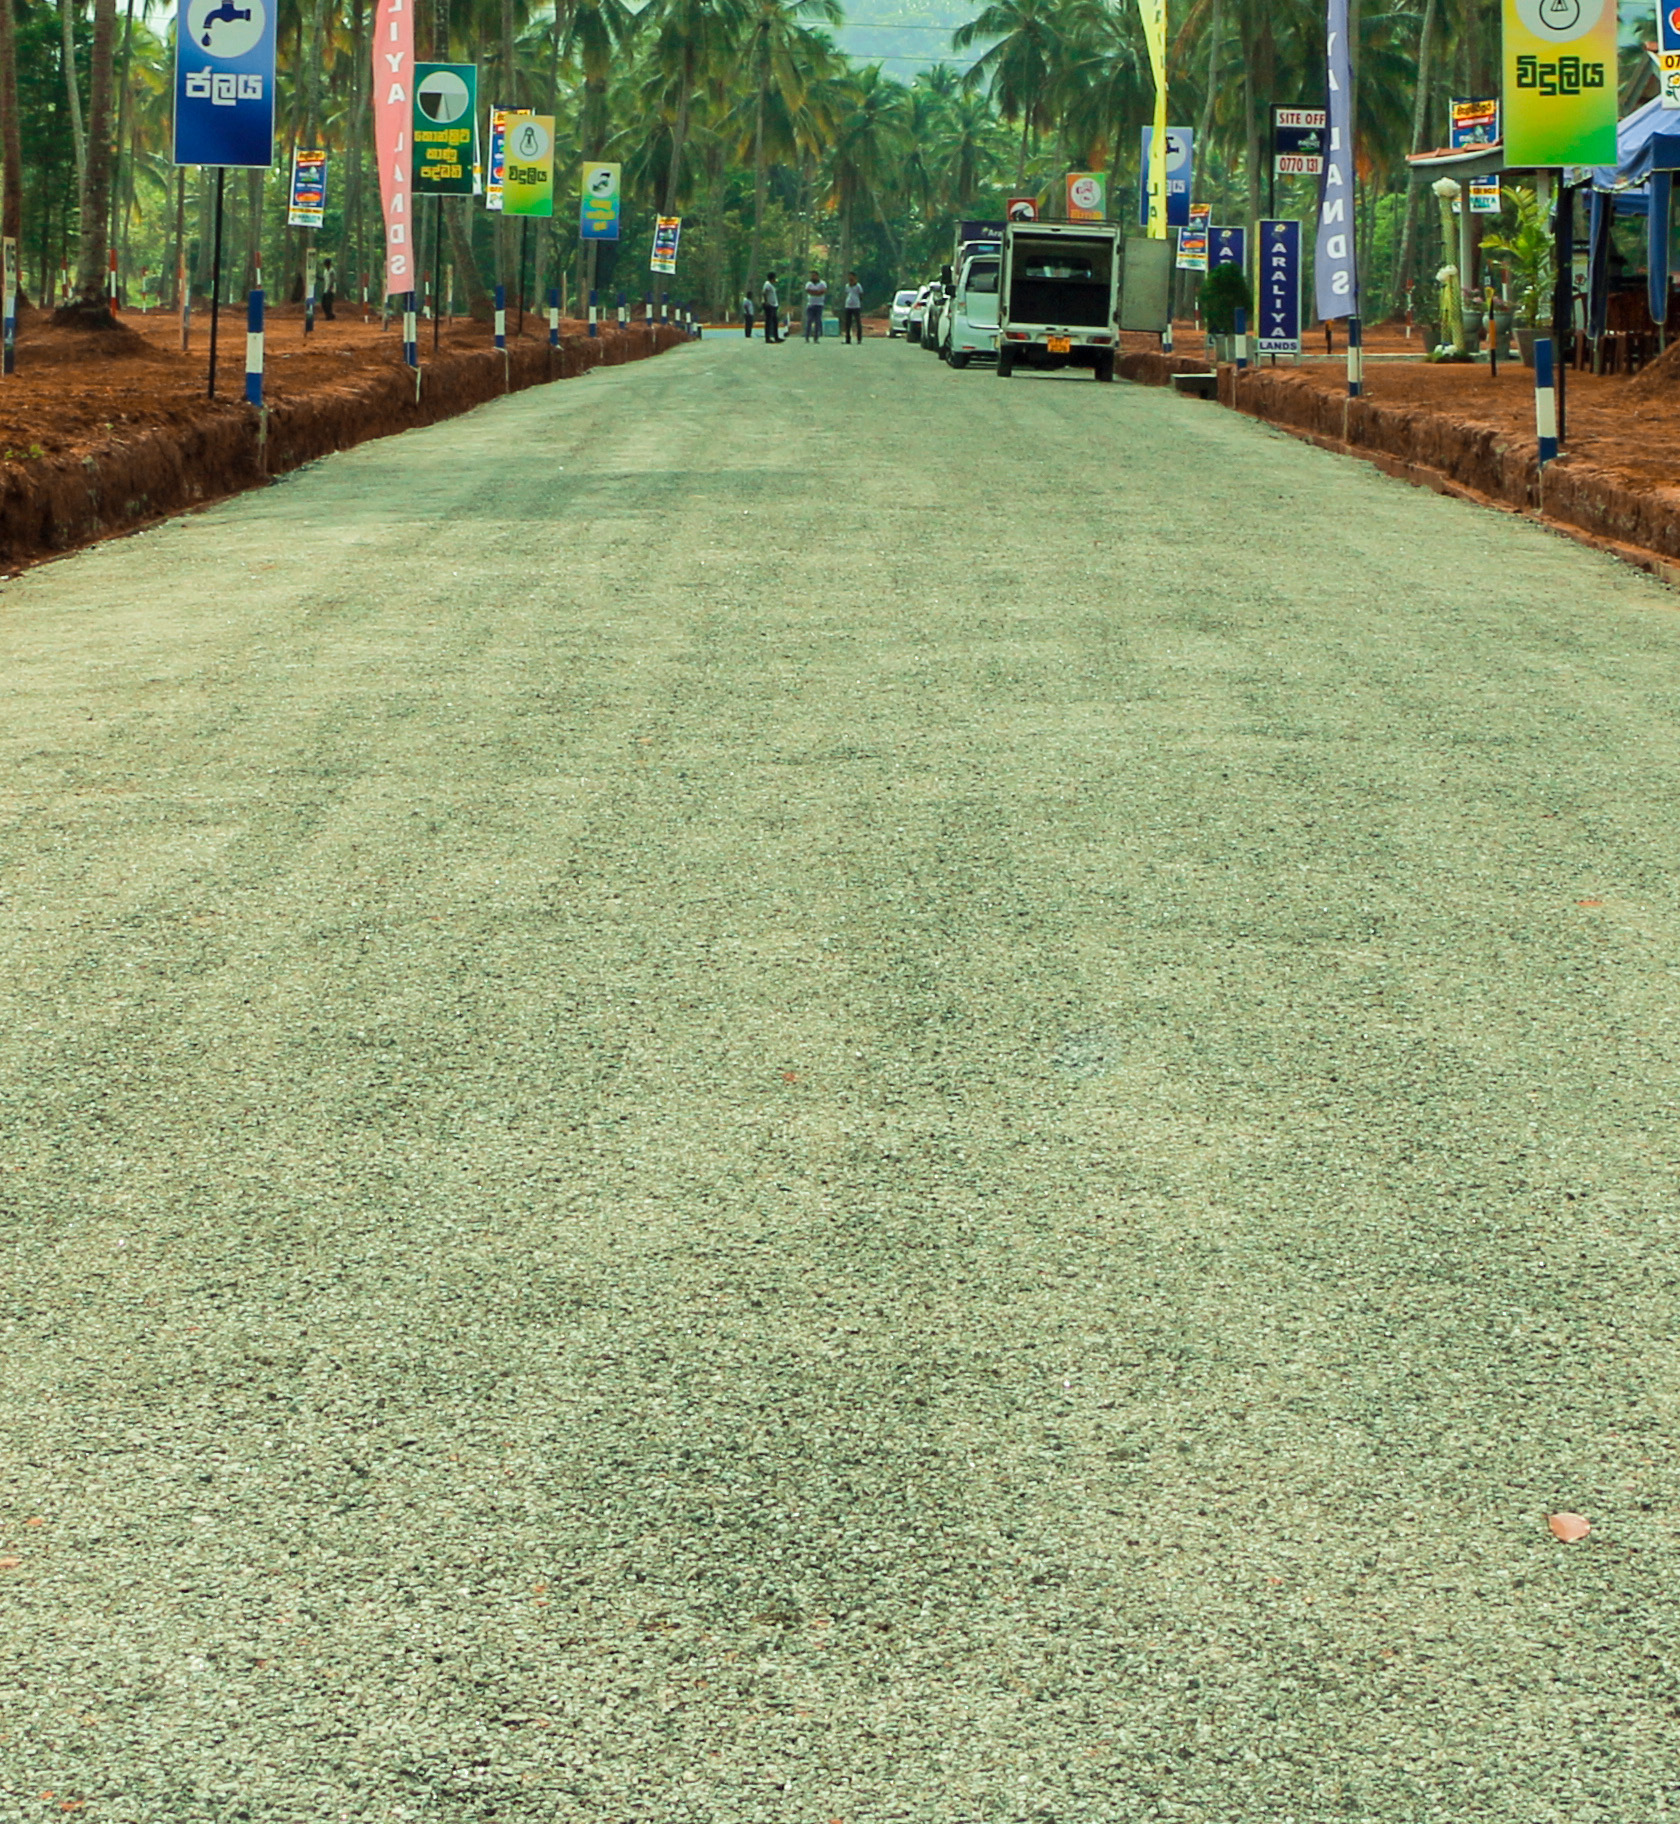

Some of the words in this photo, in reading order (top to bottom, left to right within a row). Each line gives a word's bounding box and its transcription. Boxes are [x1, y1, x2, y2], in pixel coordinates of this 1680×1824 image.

[185, 66, 263, 107] ජලය
[1516, 55, 1605, 96] විදුලිය
[1279, 112, 1302, 125] SITE
[1280, 157, 1304, 172] 0770
[1306, 157, 1319, 173] 131
[1270, 242, 1288, 337] ARALIYA
[1259, 341, 1298, 351] LANDS
